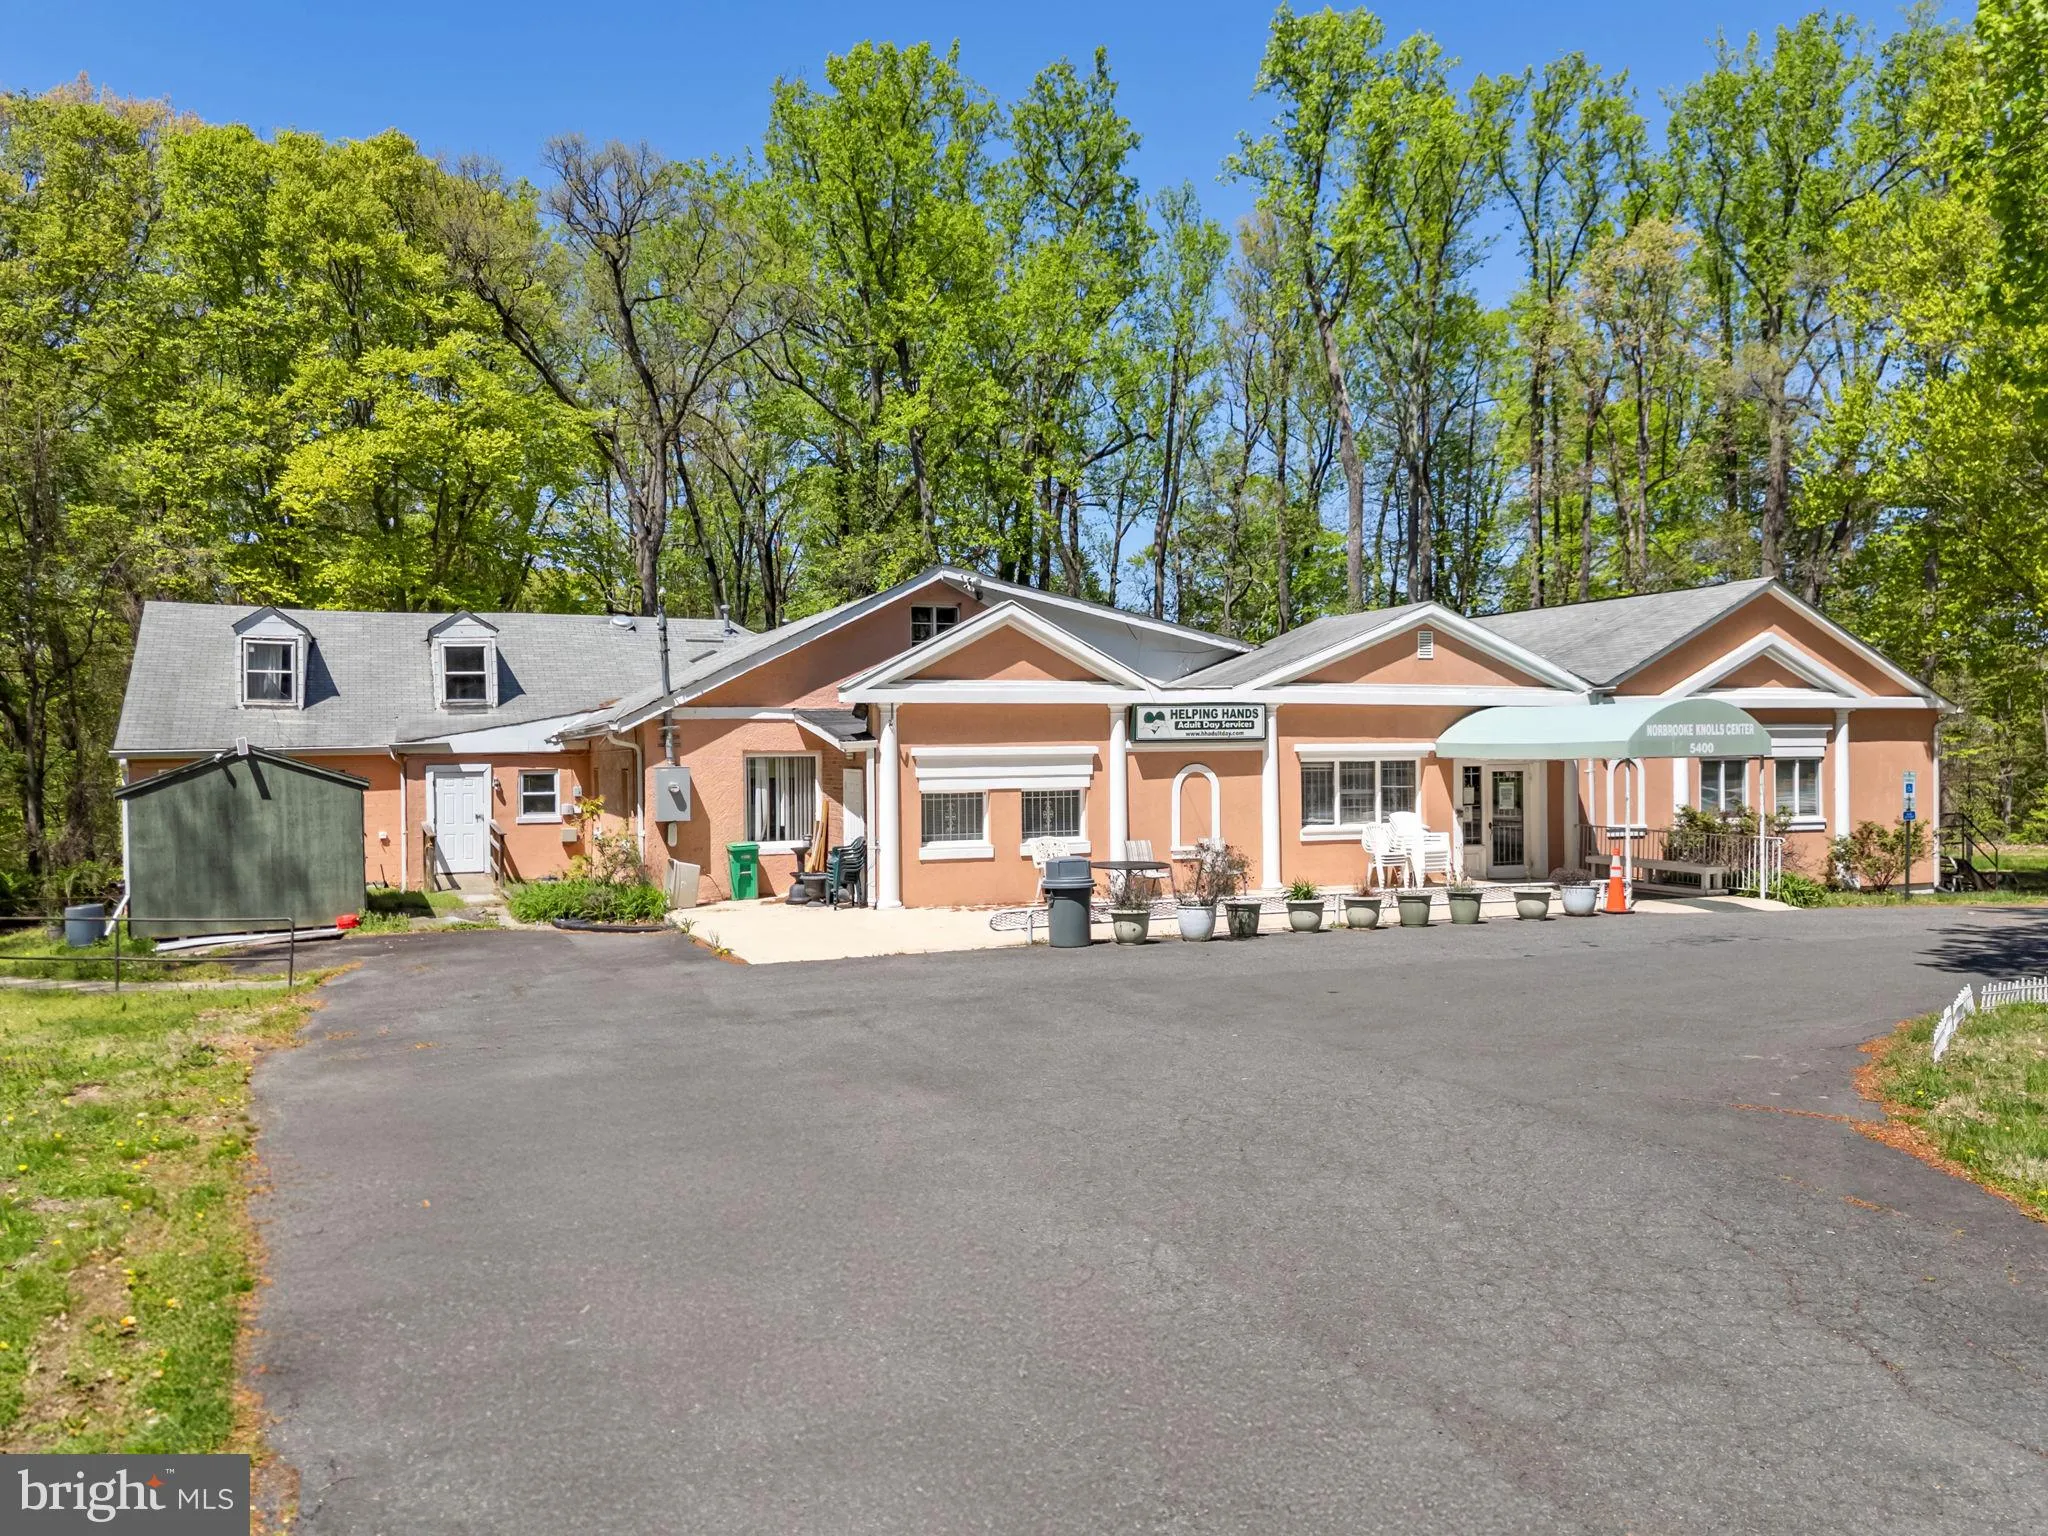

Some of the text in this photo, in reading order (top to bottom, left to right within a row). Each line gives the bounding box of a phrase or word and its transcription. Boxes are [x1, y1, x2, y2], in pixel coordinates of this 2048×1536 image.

[1170, 708, 1259, 720] HELPING HANDS
[1178, 720, 1252, 730] Adult Day Services
[1647, 723, 1755, 737] NORBROOKE KNOLLS CENTER
[1186, 730, 1244, 738] www.hhadultday.com
[1690, 742, 1714, 753] 5400
